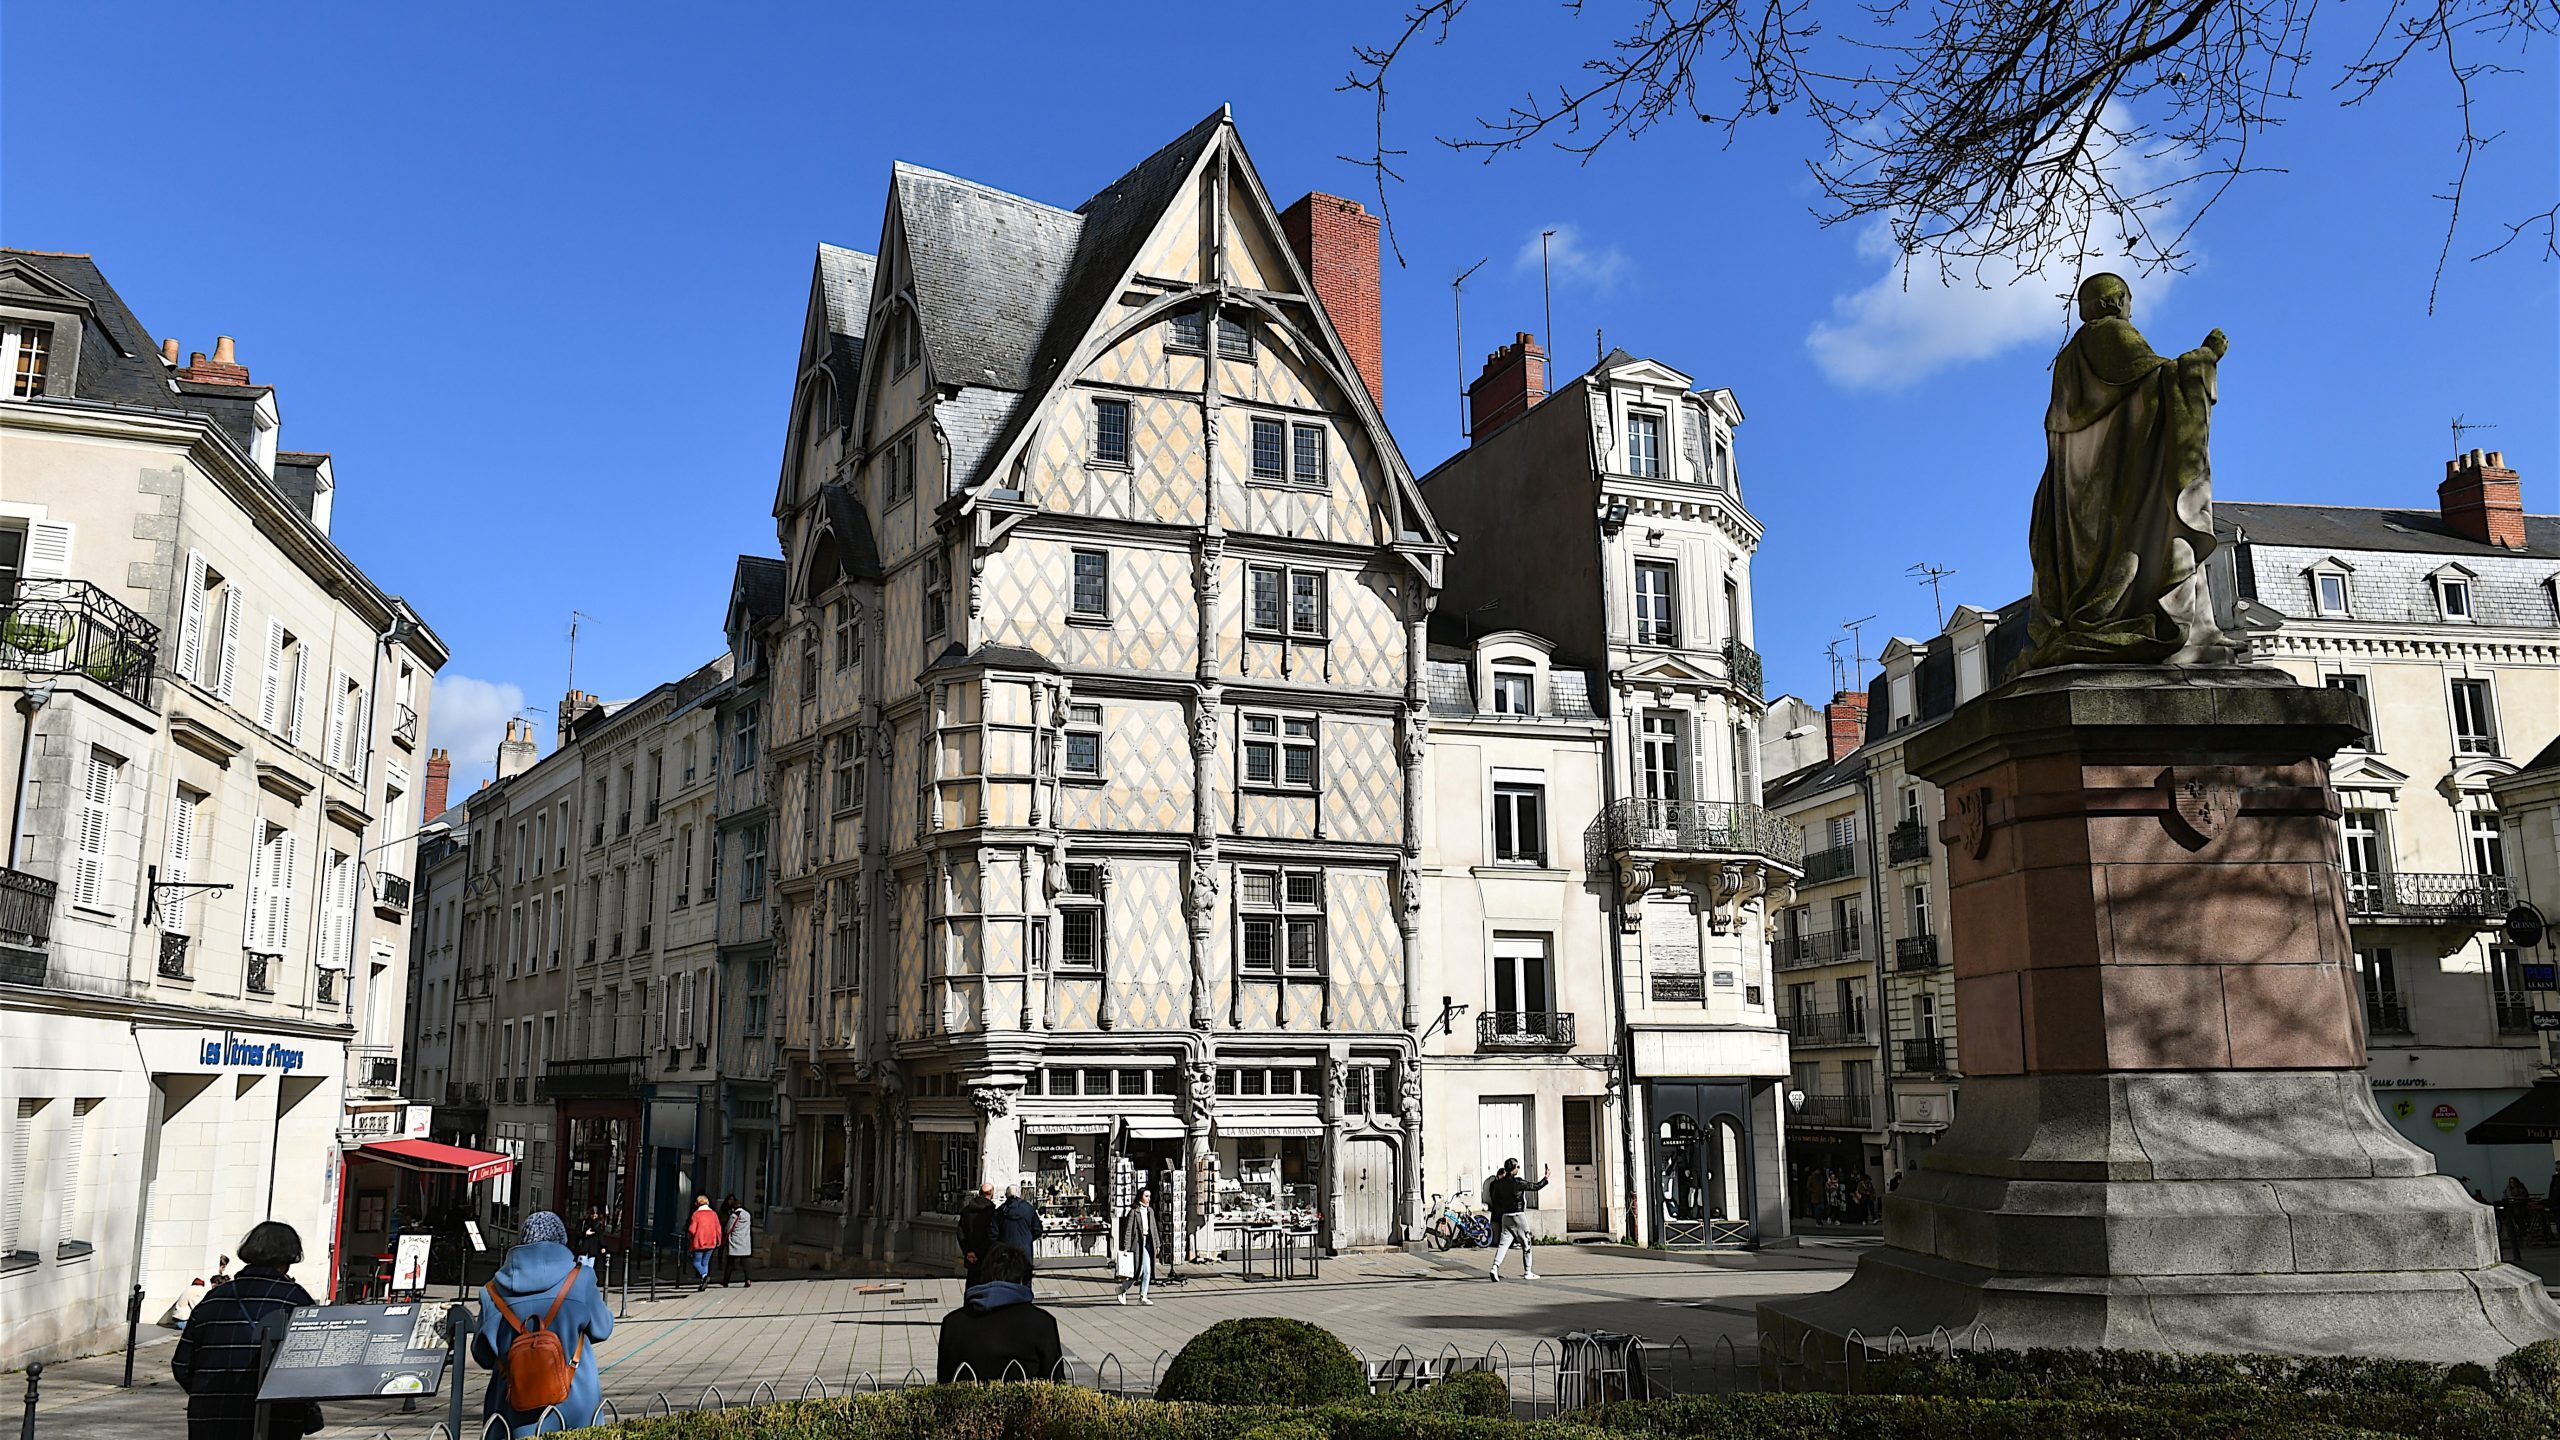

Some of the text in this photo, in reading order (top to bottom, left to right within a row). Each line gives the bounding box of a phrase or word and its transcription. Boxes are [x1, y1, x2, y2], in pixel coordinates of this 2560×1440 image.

[2526, 967, 2553, 978] PUB
[223, 1030, 264, 1066] Vitrines
[1226, 1127, 1316, 1136] LA MAISON DES ARTISANS
